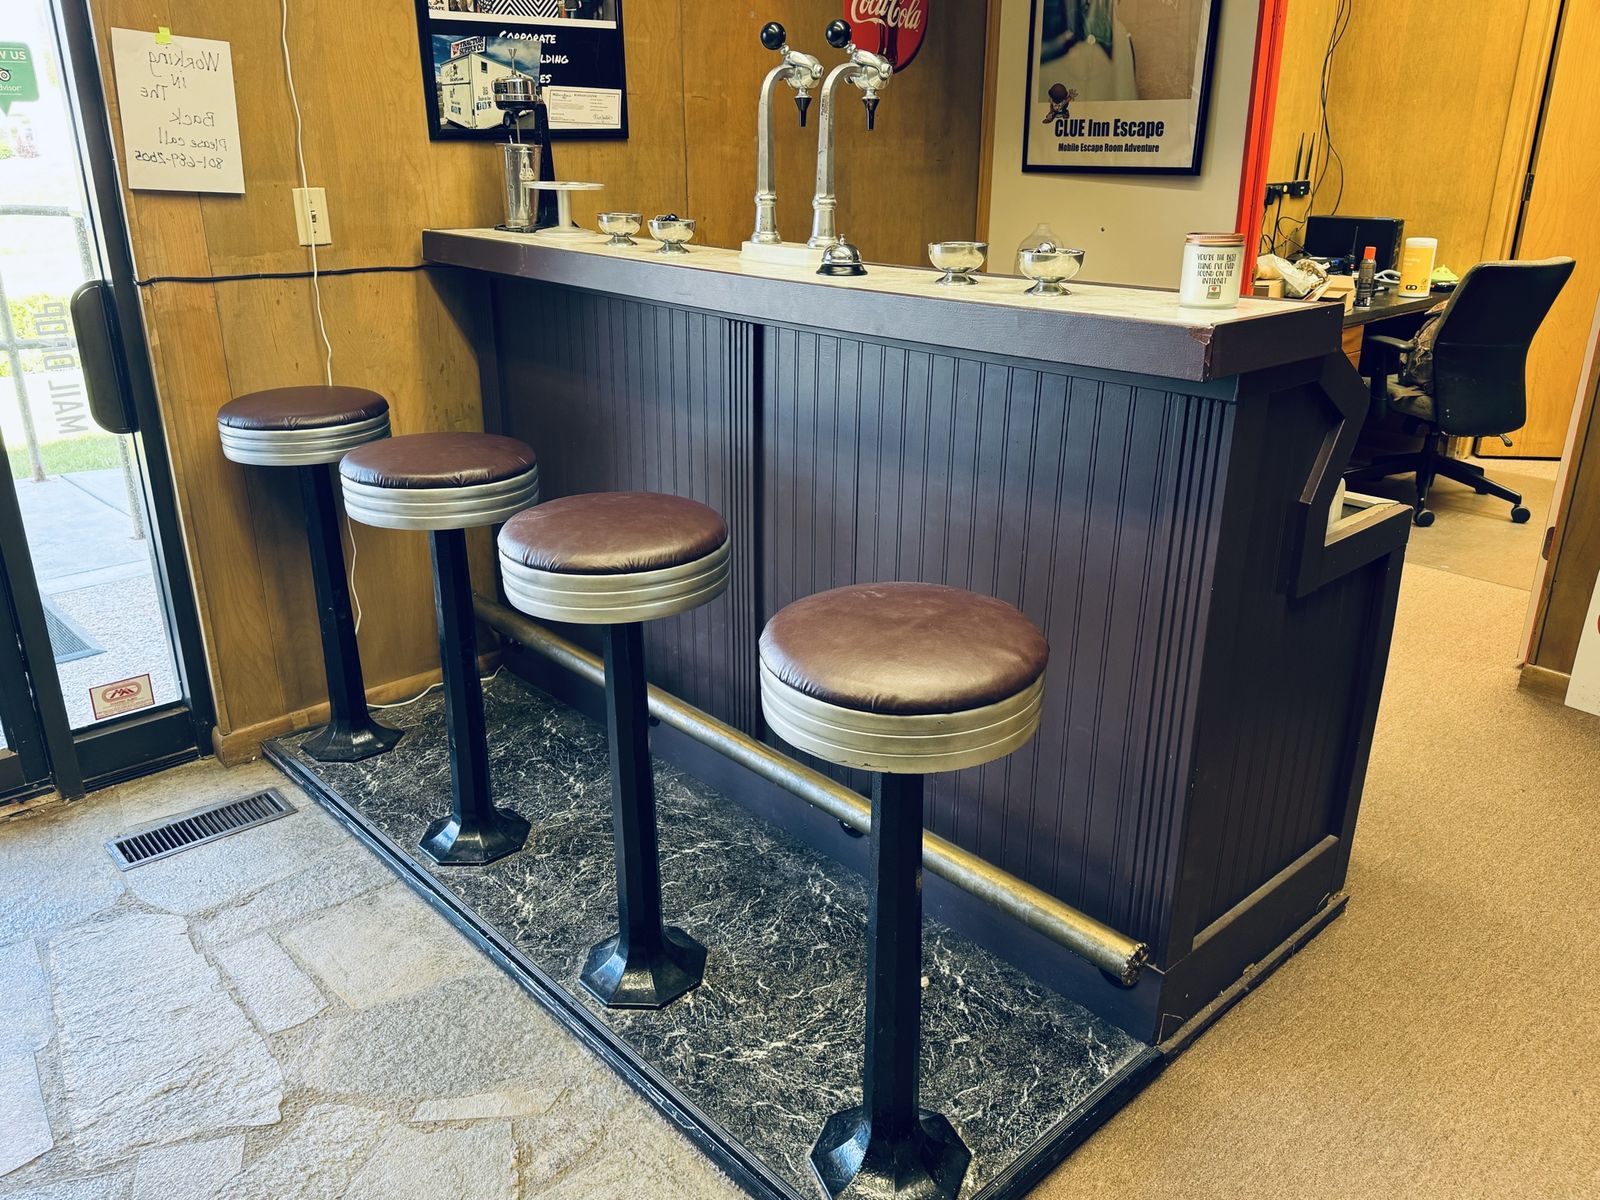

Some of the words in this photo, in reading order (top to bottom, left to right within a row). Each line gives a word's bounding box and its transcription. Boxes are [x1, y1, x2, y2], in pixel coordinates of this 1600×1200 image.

[10, 50, 26, 60] US
[1055, 119, 1086, 137] CLUE
[1087, 119, 1110, 137] Inn
[1113, 118, 1165, 139] Escape
[1058, 143, 1079, 152] Mobile
[1080, 143, 1103, 153] Escape
[1104, 143, 1123, 152] Room
[1124, 143, 1160, 153] Adventure
